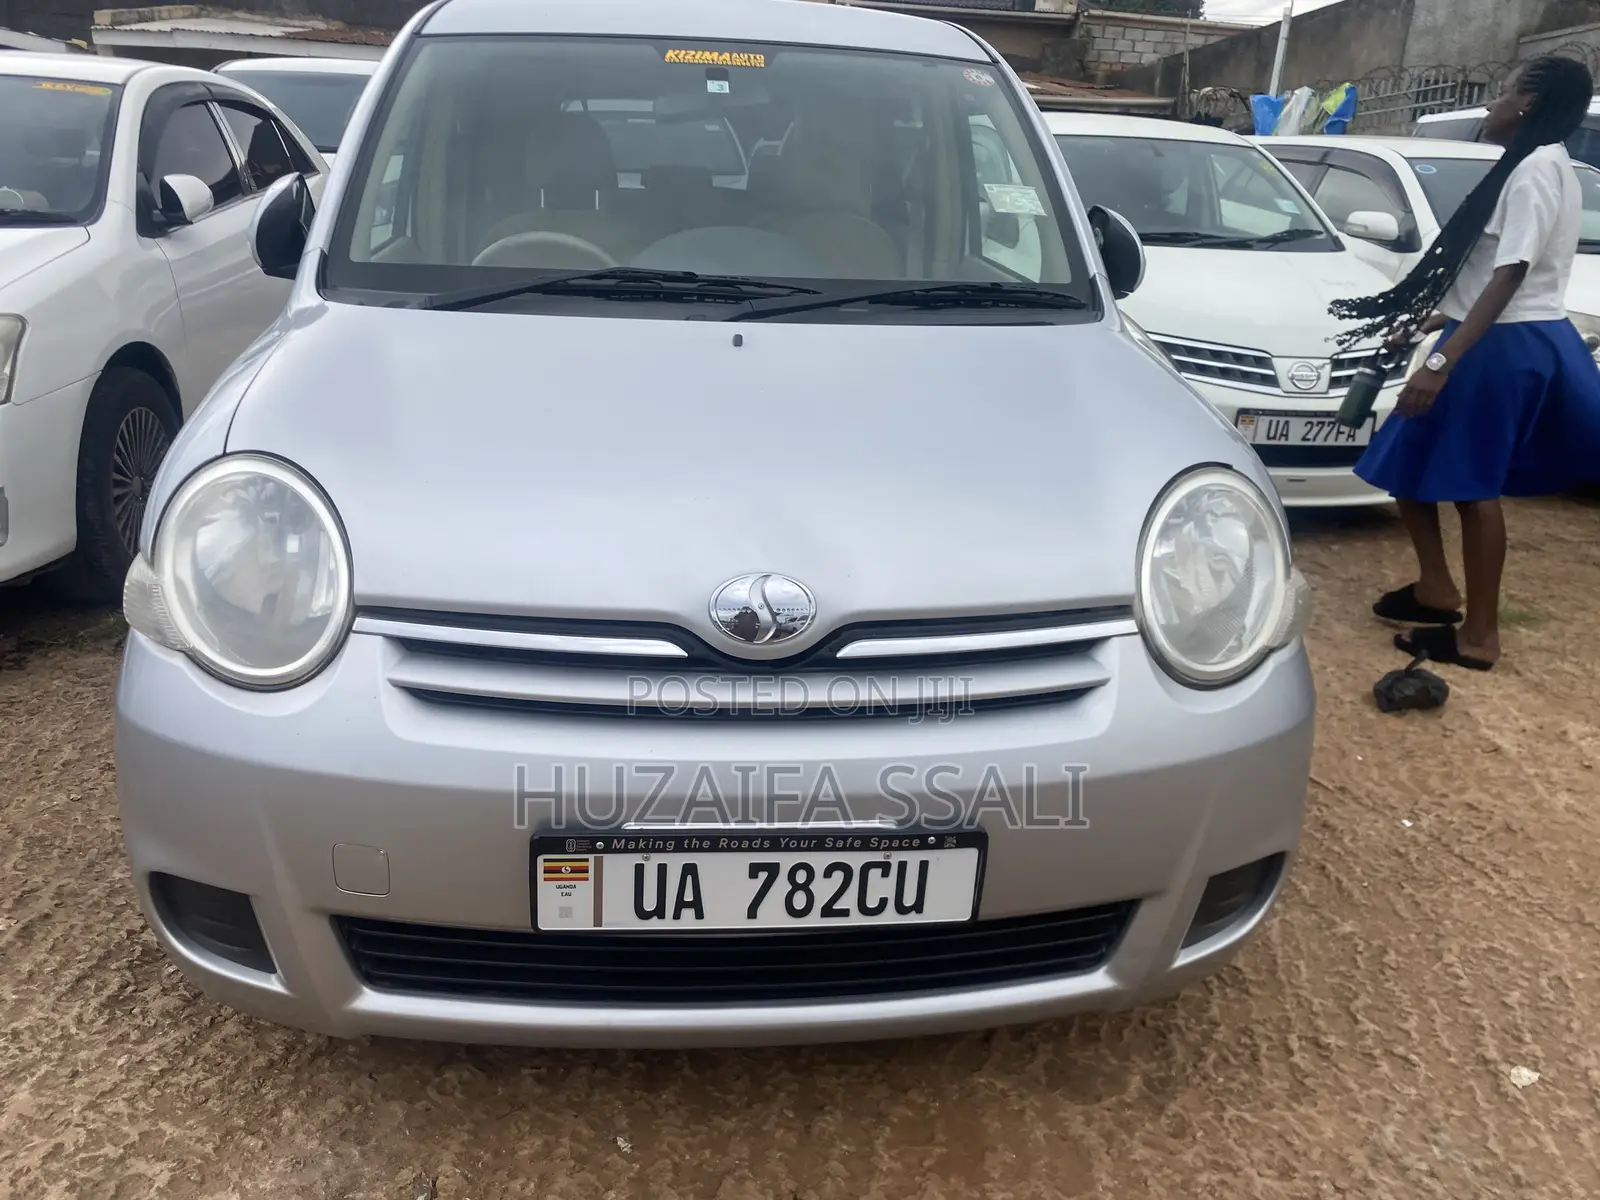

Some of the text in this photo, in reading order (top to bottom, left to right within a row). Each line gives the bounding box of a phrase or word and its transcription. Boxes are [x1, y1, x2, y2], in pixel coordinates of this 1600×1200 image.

[1266, 419, 1290, 442] UA
[612, 837, 921, 851] Making the Roads Your Safe Space
[634, 859, 930, 921] UA 782CU
